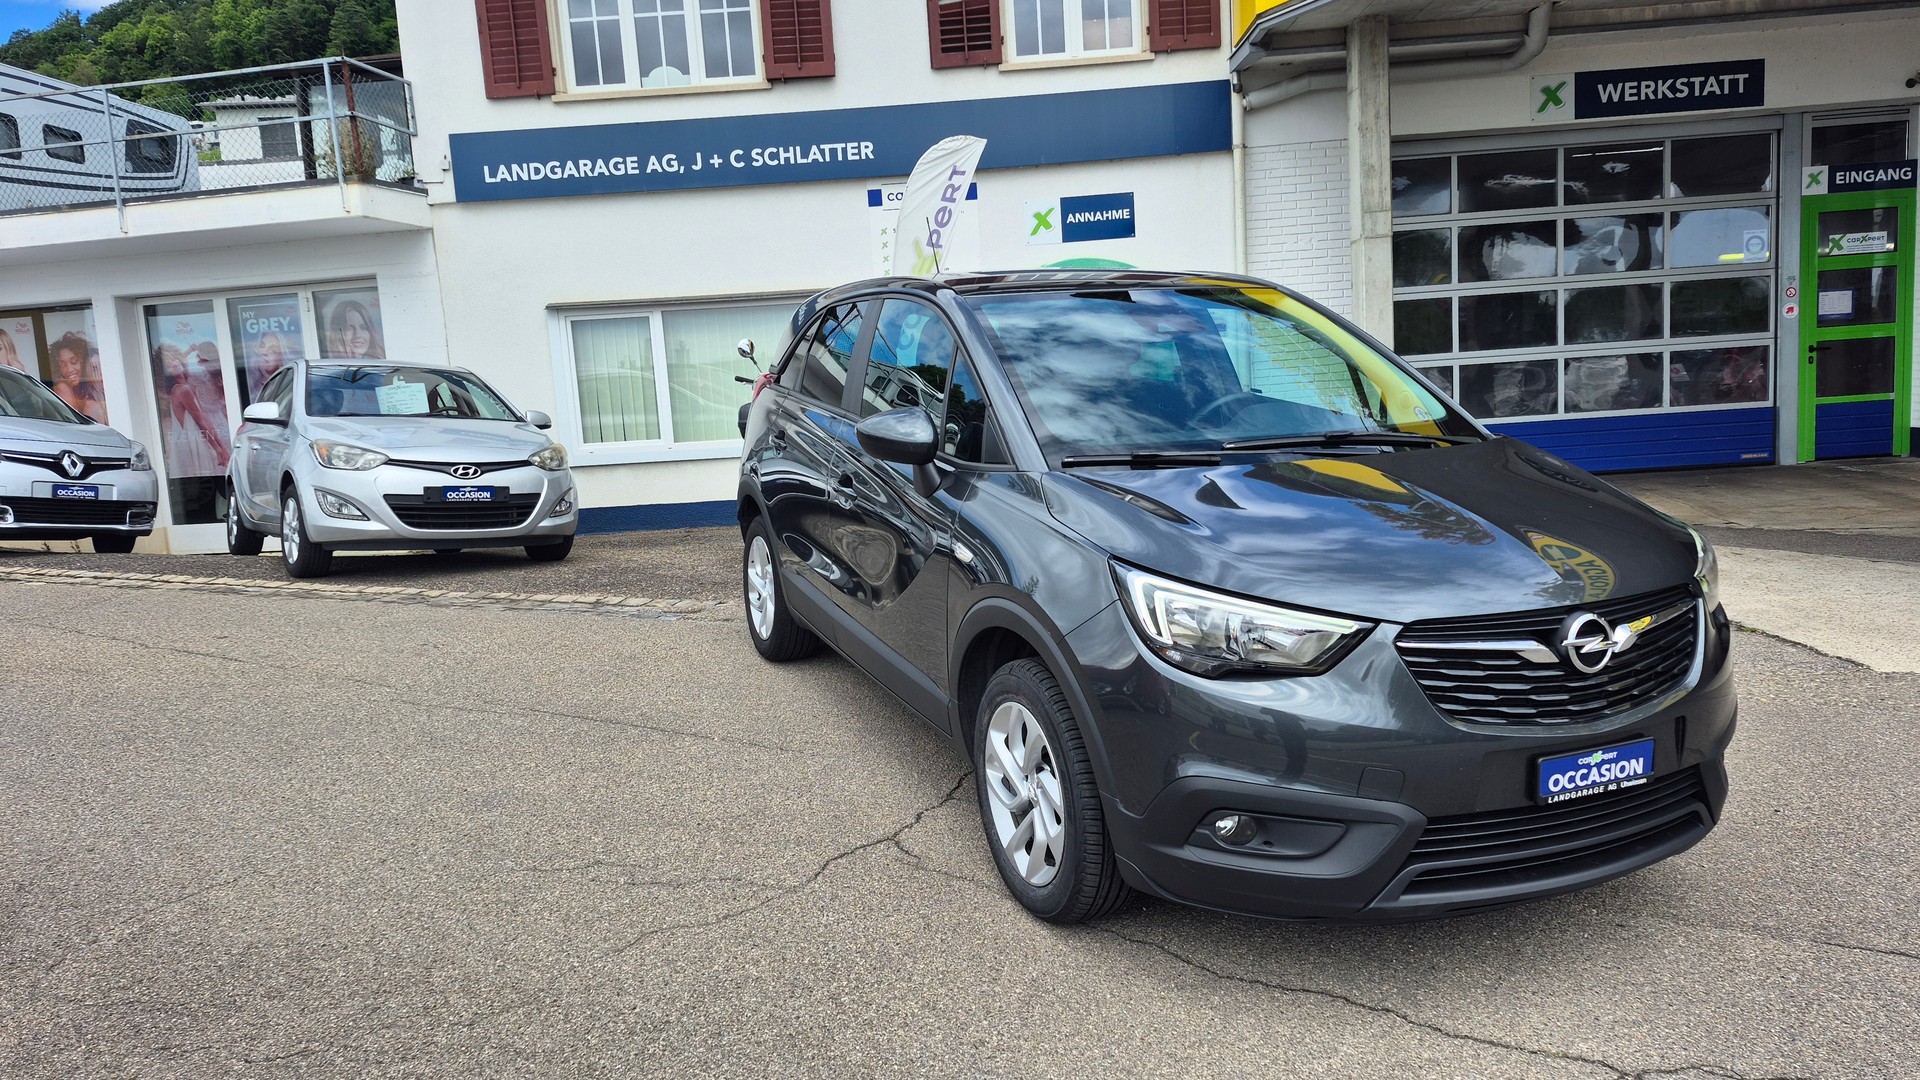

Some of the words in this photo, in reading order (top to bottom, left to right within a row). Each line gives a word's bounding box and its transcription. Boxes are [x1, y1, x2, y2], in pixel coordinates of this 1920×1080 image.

[1597, 73, 1749, 103] WERKSTATT
[483, 155, 640, 184] LANDGARAGE
[646, 153, 685, 175] AG,
[691, 152, 702, 171] J
[729, 148, 746, 168] C
[751, 141, 875, 167] SCHLATTER
[1835, 167, 1913, 185] EINGANG
[1066, 208, 1131, 224] ANNAHME
[242, 311, 255, 319] MY
[246, 316, 295, 334] GREY.
[57, 489, 95, 497] OCCASION
[446, 491, 491, 499] OCCASION
[1548, 757, 1644, 792] OCCASION
[1547, 785, 1605, 804] LANDGARAGE
[1607, 783, 1618, 791] AG
